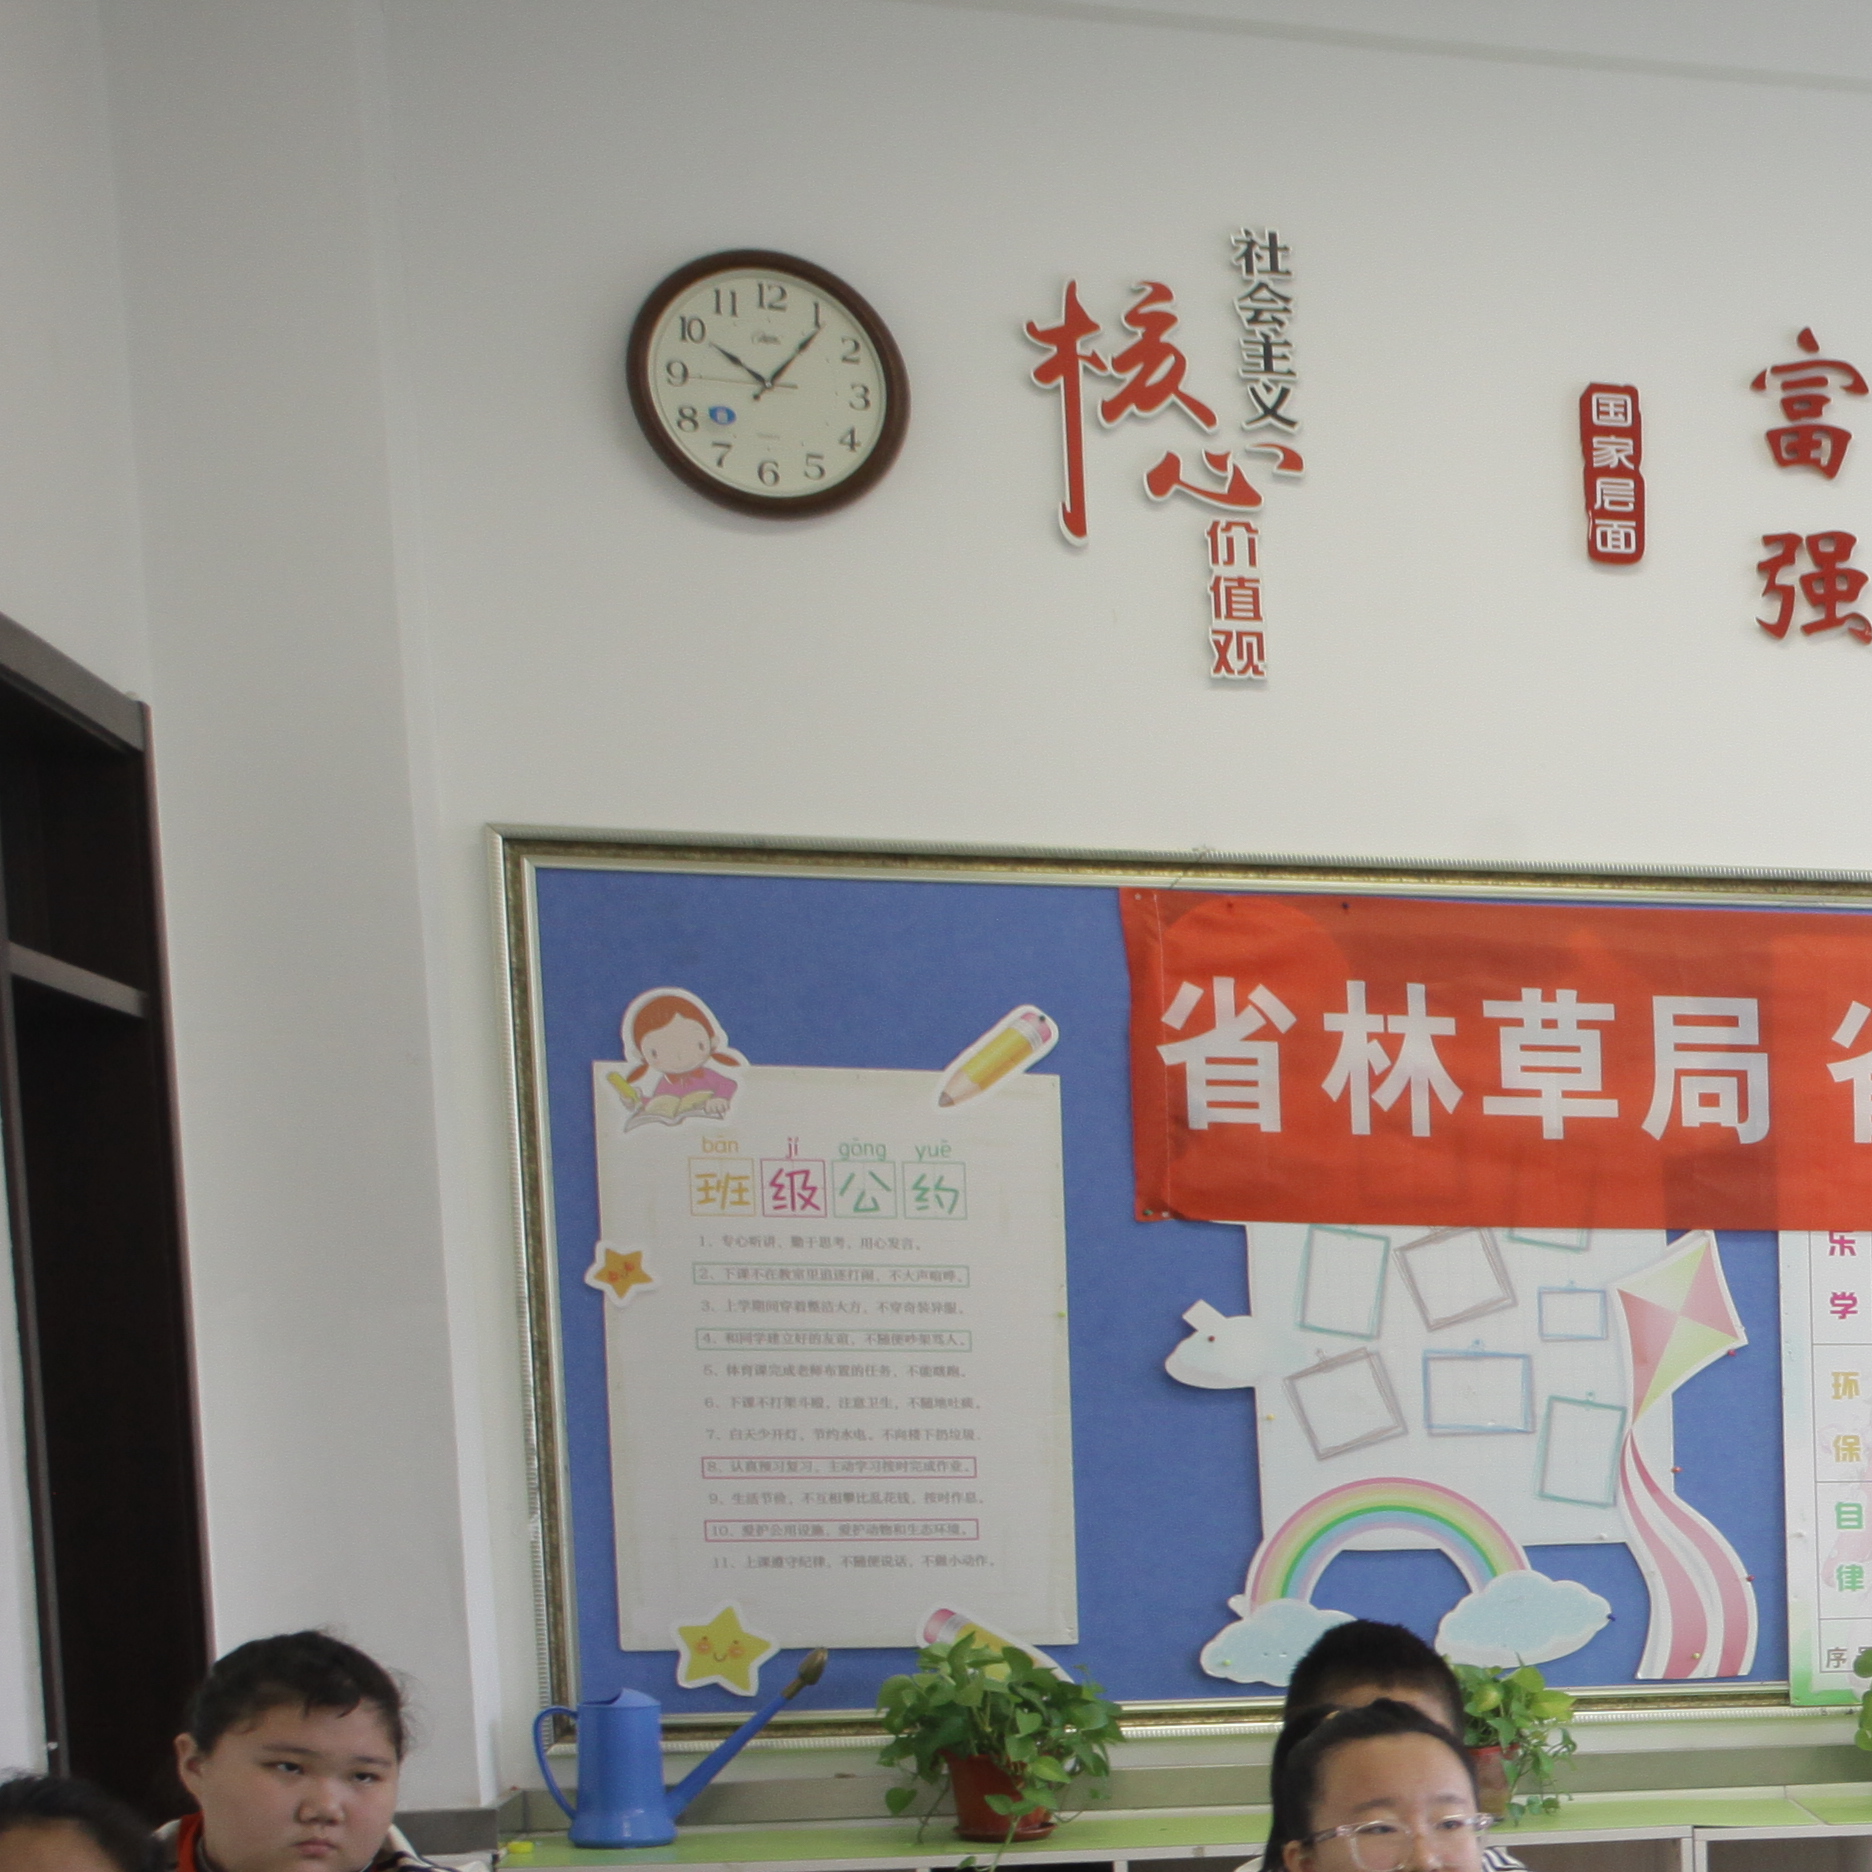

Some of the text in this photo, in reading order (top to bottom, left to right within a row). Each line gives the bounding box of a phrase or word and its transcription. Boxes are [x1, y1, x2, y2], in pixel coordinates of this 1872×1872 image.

[714, 288, 738, 318] 11
[757, 282, 788, 312] 12
[680, 315, 706, 344] 10
[813, 302, 823, 330] 1
[1231, 228, 1298, 430] 社会主义
[841, 337, 861, 364] 2
[666, 360, 689, 387] 9
[849, 384, 871, 411] 3
[676, 405, 699, 432] 8
[1024, 279, 1304, 545] 核心
[839, 426, 861, 452] 4
[711, 441, 733, 468] 7
[804, 453, 826, 480] 5
[757, 460, 780, 487] 6
[1590, 391, 1638, 556] 国家层面
[1206, 519, 1267, 677] 价值观
[1157, 973, 1771, 1143] 省林草局
[694, 1168, 960, 1215] 班级公约
